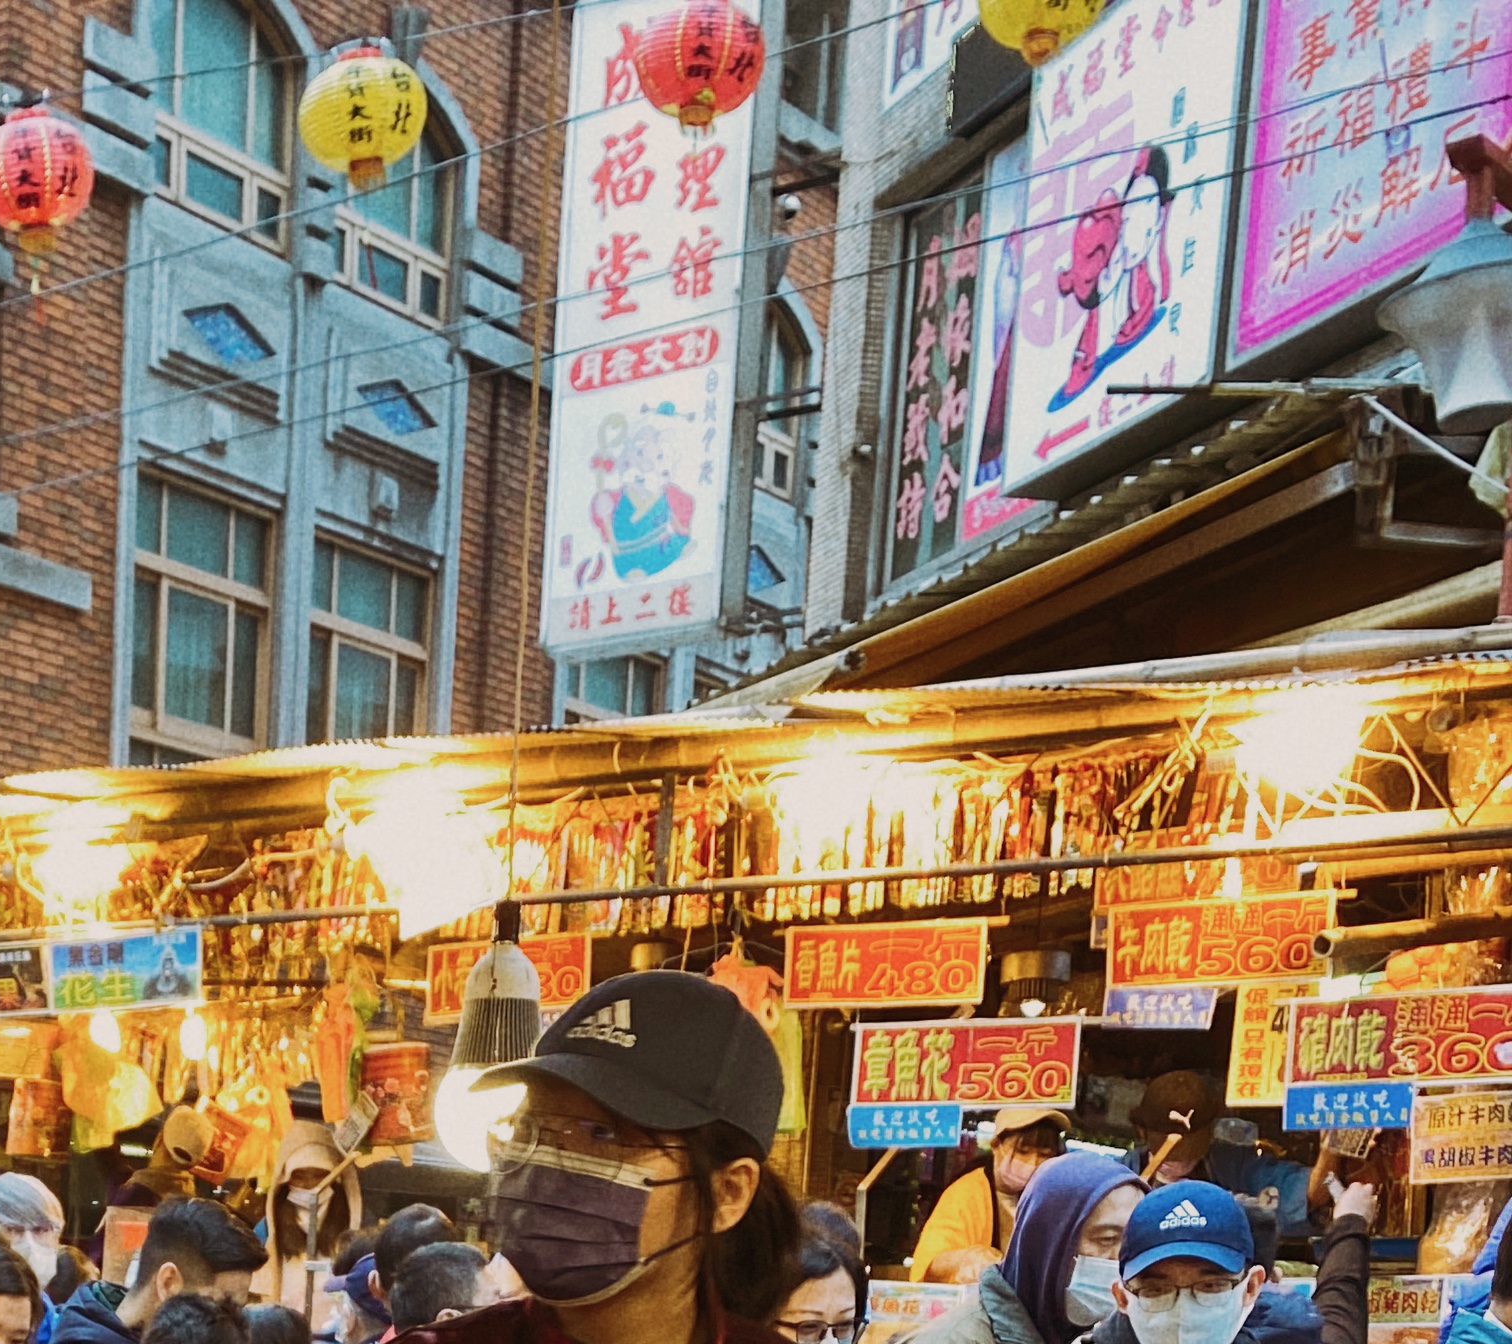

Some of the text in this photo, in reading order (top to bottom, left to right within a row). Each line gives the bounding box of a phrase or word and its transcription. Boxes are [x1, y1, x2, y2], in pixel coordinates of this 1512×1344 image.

[390, 66, 412, 135] 台北
[54, 127, 78, 199] 台北
[796, 927, 981, 993] 香魚片 一斤
[1117, 914, 1194, 981] 牛肉乾
[1194, 933, 1316, 978] 560
[58, 969, 134, 1007] 花生
[865, 960, 974, 997] 480
[976, 1026, 1058, 1057] 一斤
[955, 1060, 1071, 1101] 560
[1159, 1213, 1208, 1231] adidas
